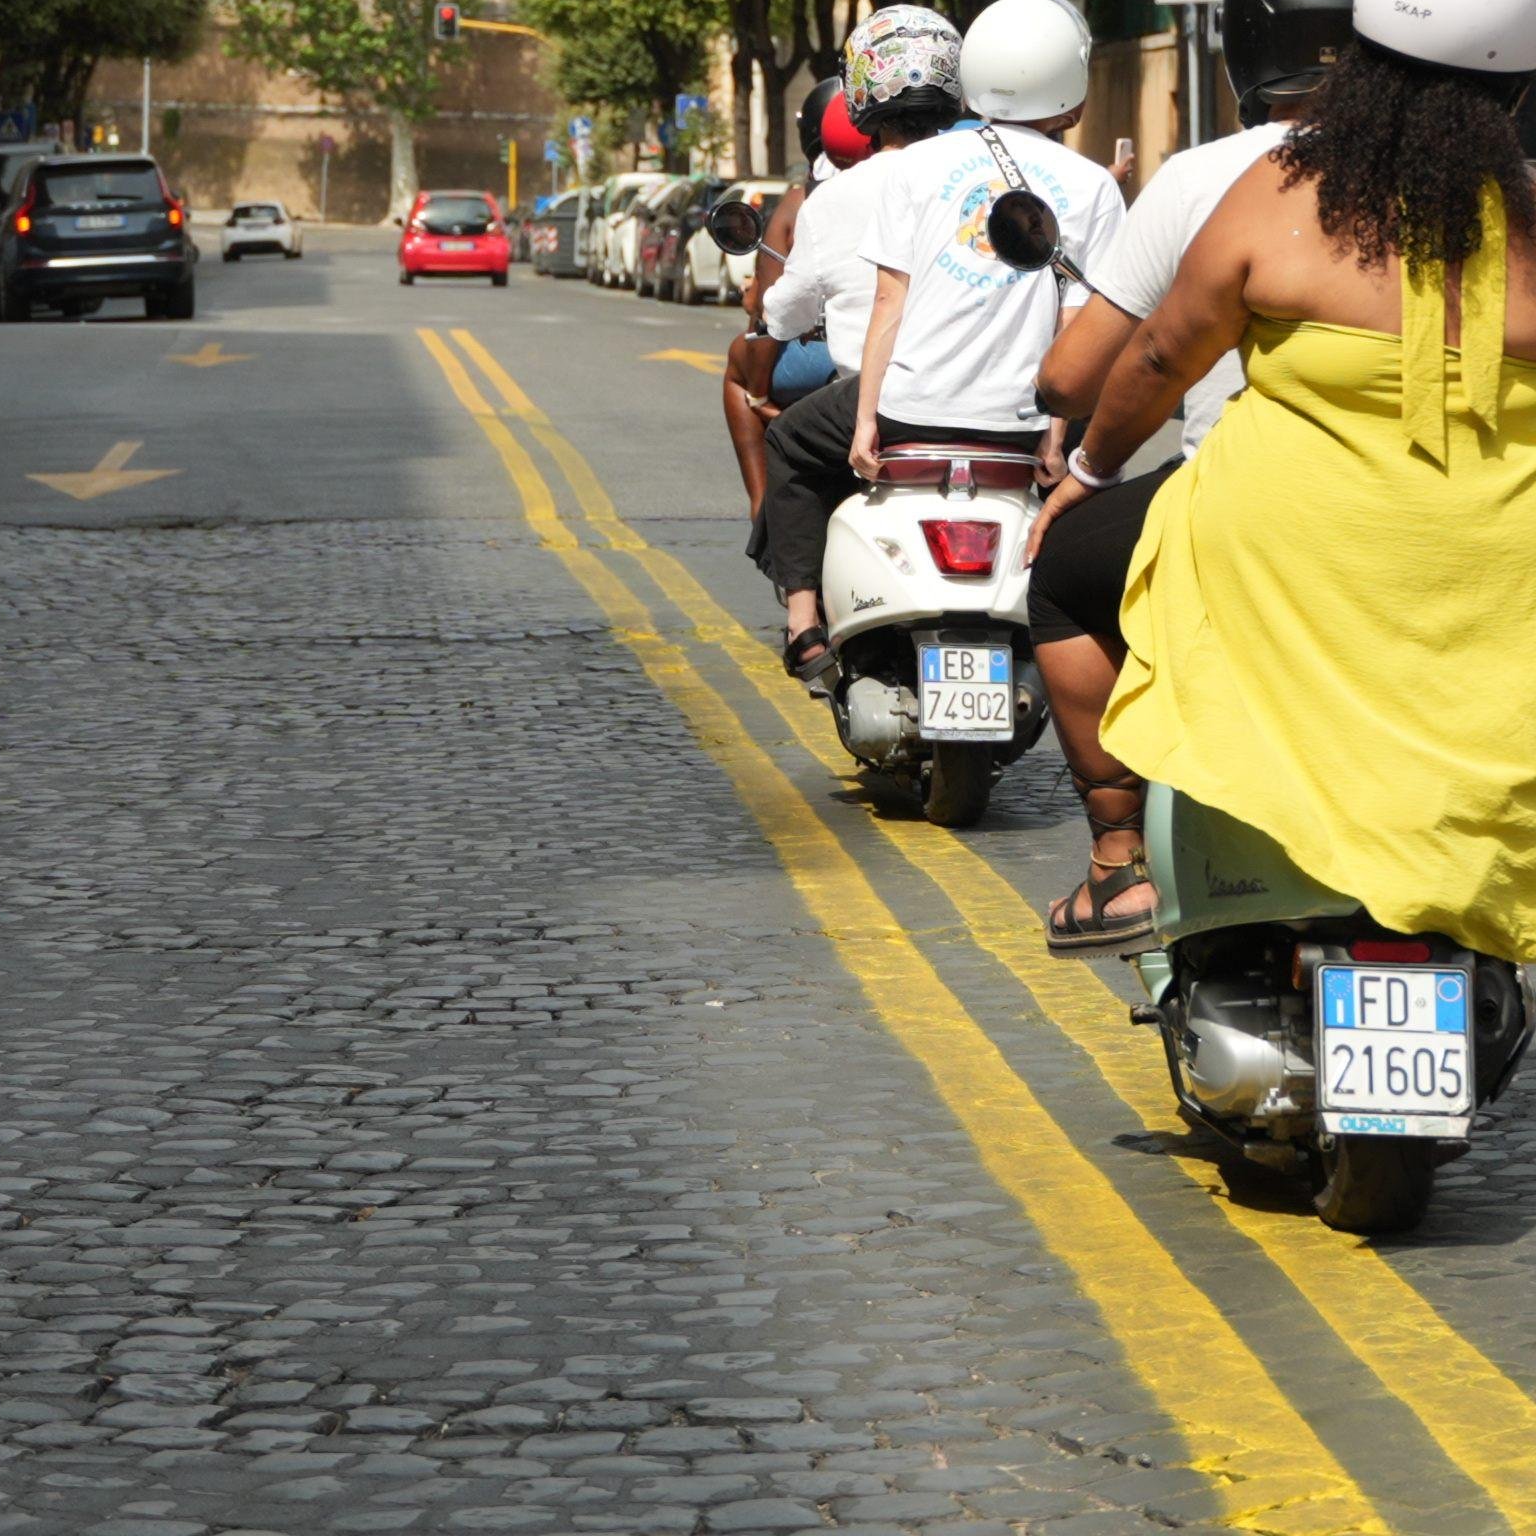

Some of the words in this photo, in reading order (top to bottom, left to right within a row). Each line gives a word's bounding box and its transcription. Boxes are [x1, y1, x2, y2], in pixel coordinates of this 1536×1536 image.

[990, 143, 1022, 188] adidas
[943, 650, 975, 680] EB
[927, 690, 1008, 722] 74902
[1359, 976, 1409, 1026] FD
[1331, 1044, 1463, 1098] 21605
